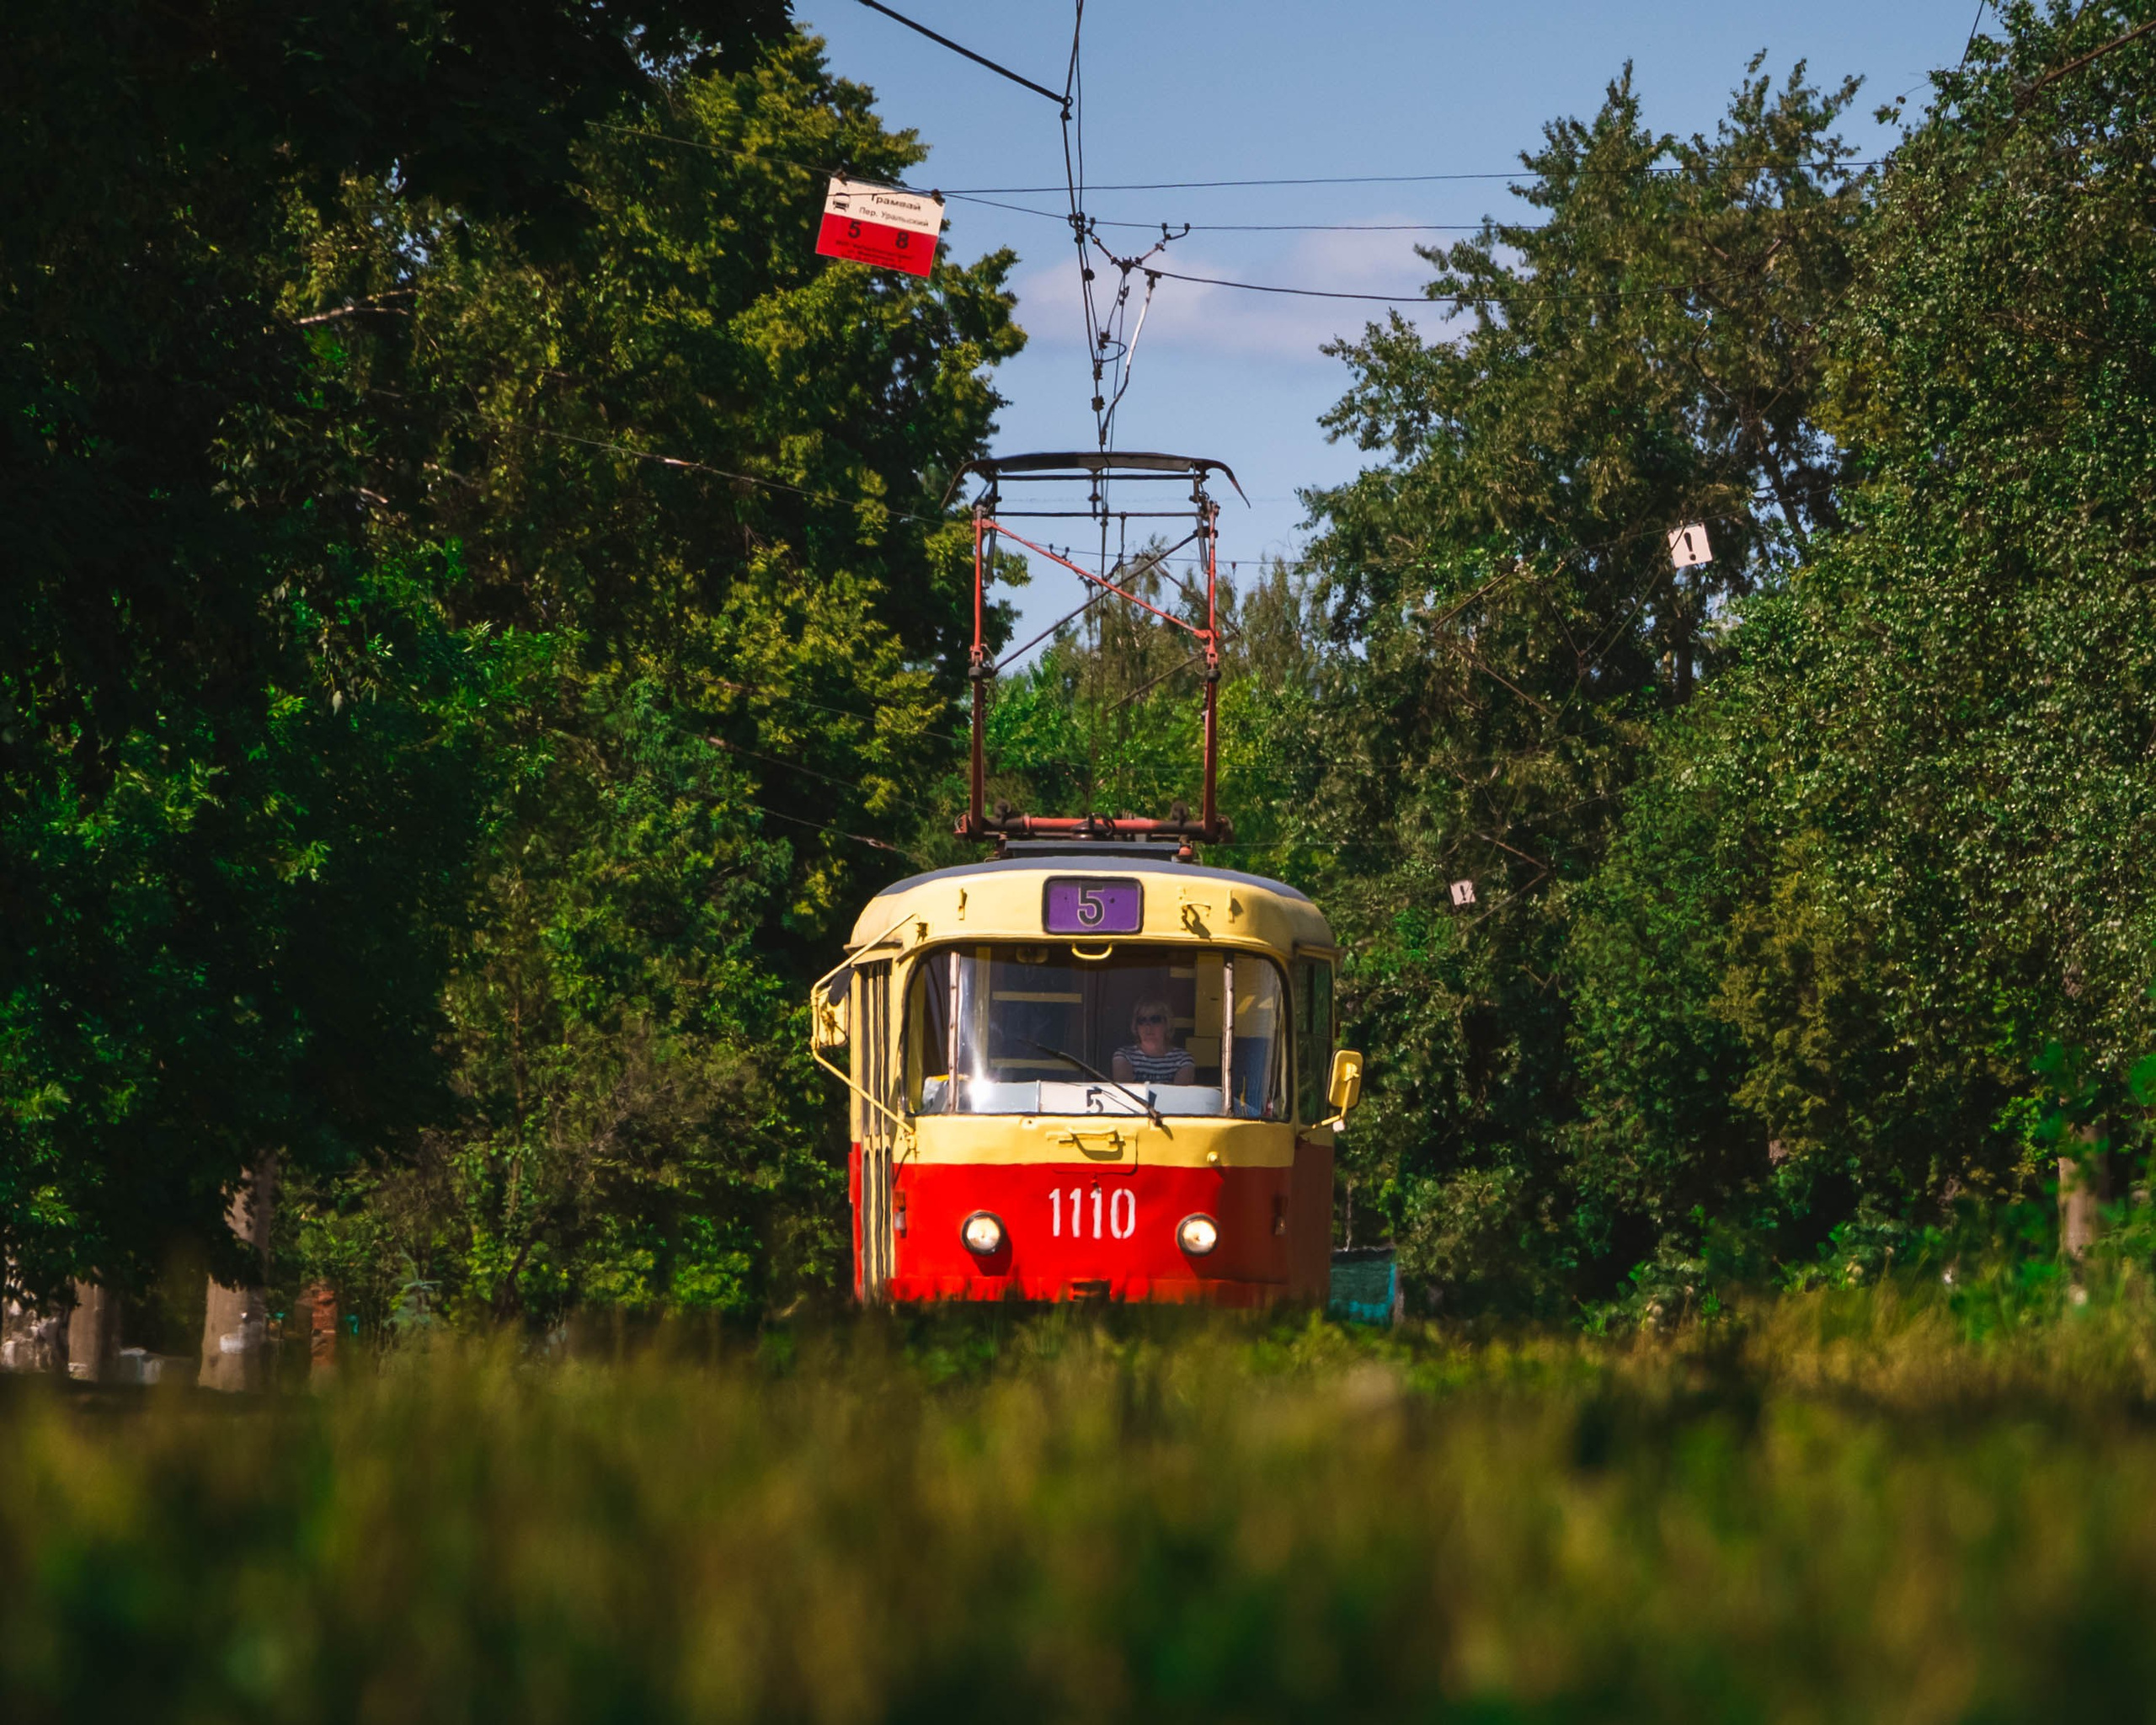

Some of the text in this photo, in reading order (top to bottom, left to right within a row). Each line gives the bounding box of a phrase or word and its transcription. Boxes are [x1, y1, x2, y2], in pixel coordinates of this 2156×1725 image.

[871, 194, 921, 211] Трамвай
[859, 206, 929, 227] Пер. Уральский
[848, 221, 861, 238] 5
[895, 232, 909, 249] 8
[1077, 881, 1105, 927] 5
[1086, 1088, 1104, 1114] 5
[1049, 1188, 1135, 1239] 1110
